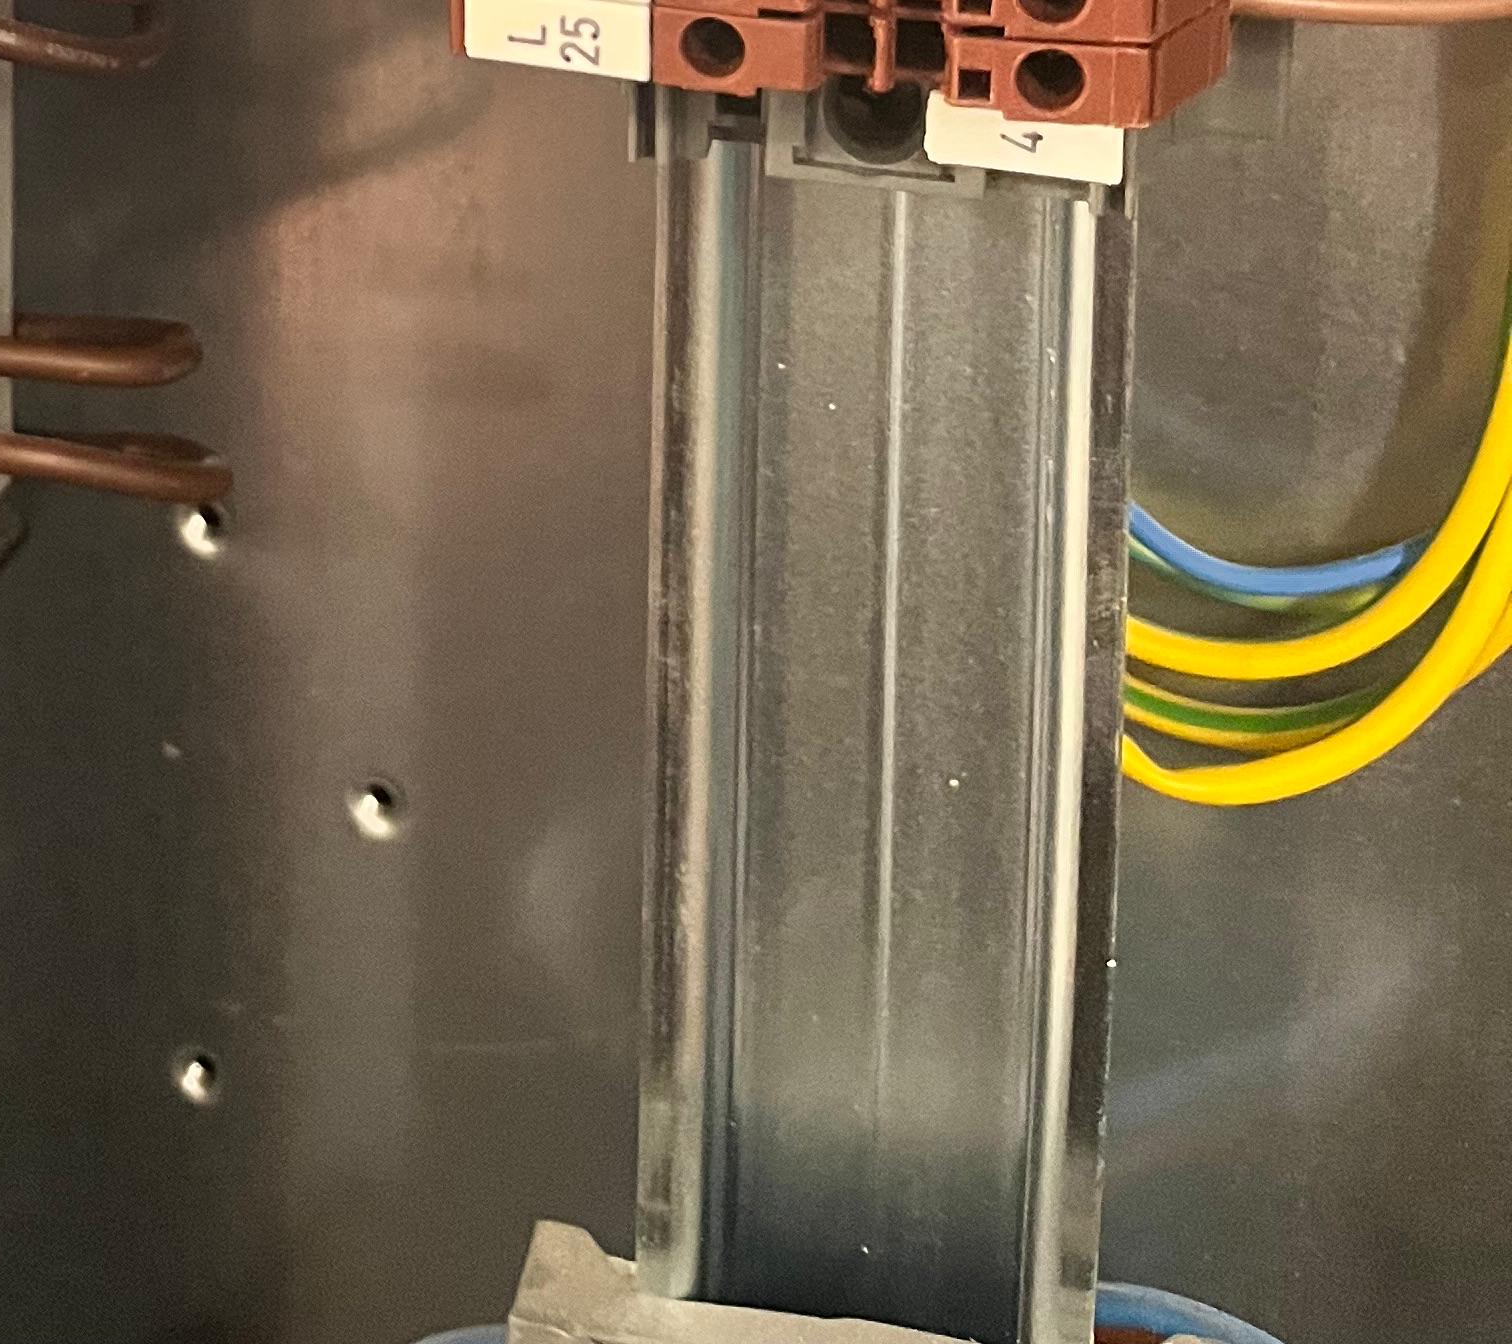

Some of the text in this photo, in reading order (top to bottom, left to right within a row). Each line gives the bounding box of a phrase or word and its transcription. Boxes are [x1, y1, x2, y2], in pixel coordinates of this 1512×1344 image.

[506, 24, 548, 46] L
[559, 15, 601, 66] 25
[999, 131, 1044, 154] 4
